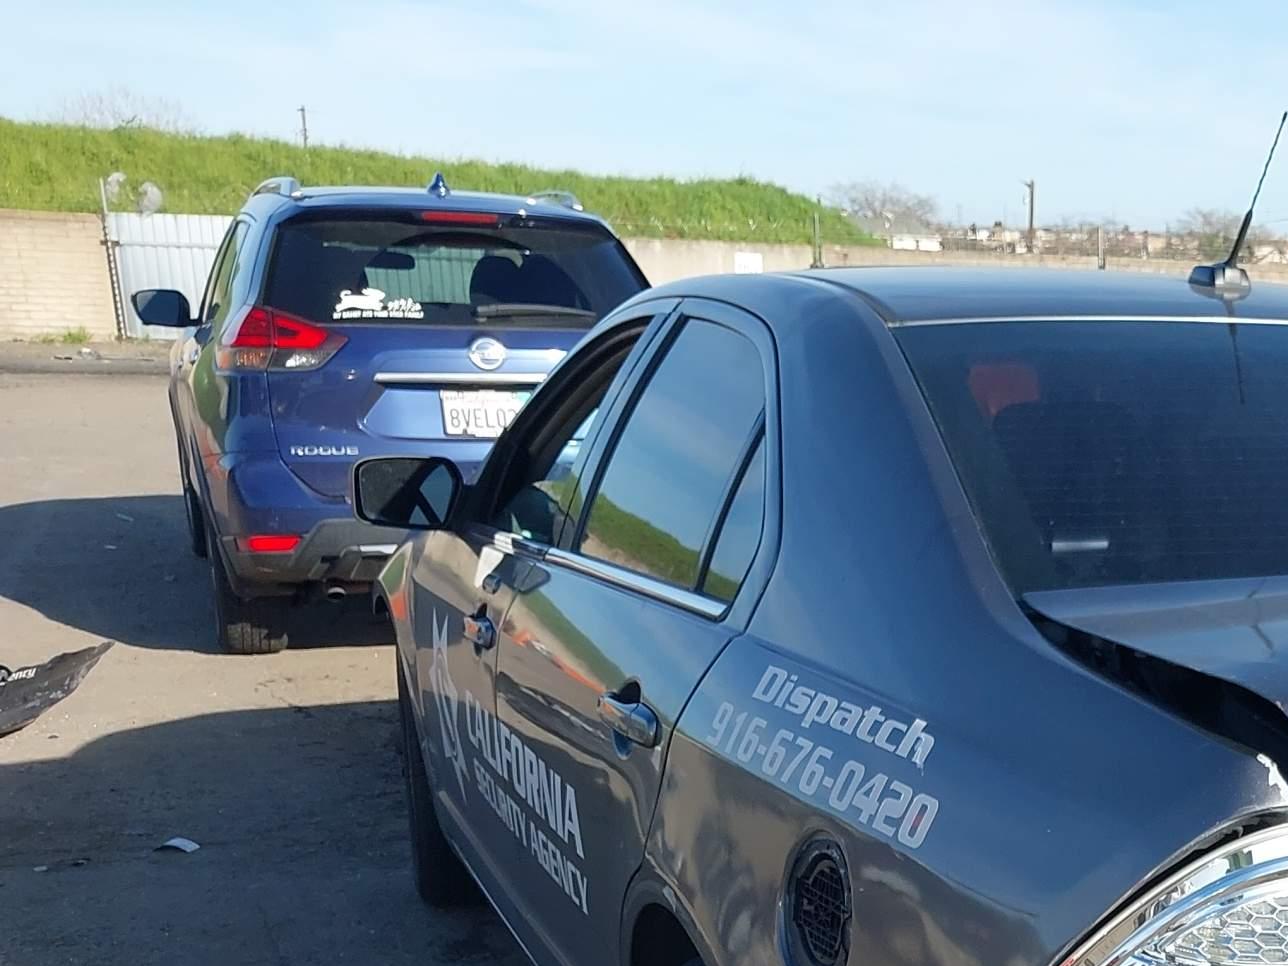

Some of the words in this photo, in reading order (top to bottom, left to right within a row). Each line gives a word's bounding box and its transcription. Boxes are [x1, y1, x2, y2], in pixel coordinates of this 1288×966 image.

[290, 446, 359, 456] ROGUE
[465, 688, 585, 860] CALIFORNIA
[705, 702, 939, 849] 916-676-0420
[751, 665, 935, 766] Dispatch
[473, 757, 528, 848] SECURITY
[530, 821, 590, 916] AGENCY
